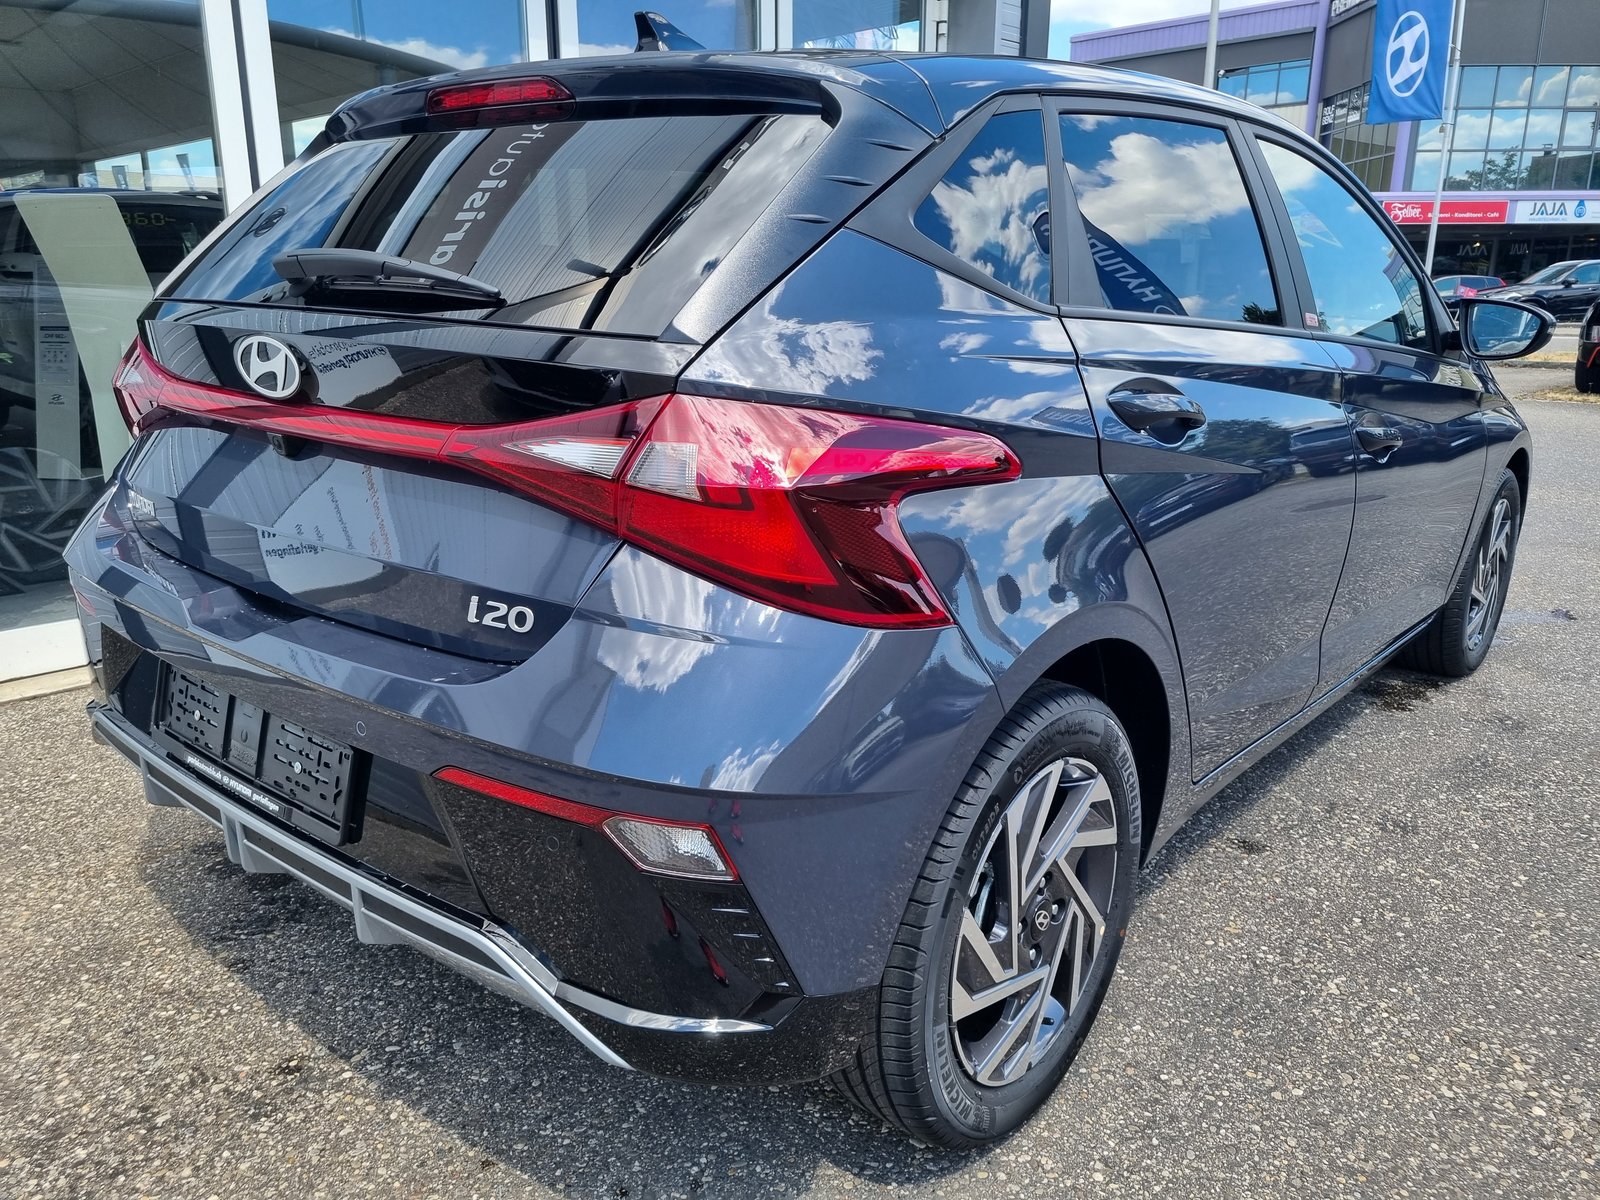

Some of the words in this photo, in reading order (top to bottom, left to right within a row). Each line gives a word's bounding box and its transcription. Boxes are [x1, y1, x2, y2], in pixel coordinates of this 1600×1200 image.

[1529, 202, 1568, 216] JAJA
[467, 595, 535, 634] i20
[1118, 750, 1141, 843] MICHELIN
[971, 802, 1000, 861] OUTSIDE
[936, 1030, 974, 1121] MICHELIN
